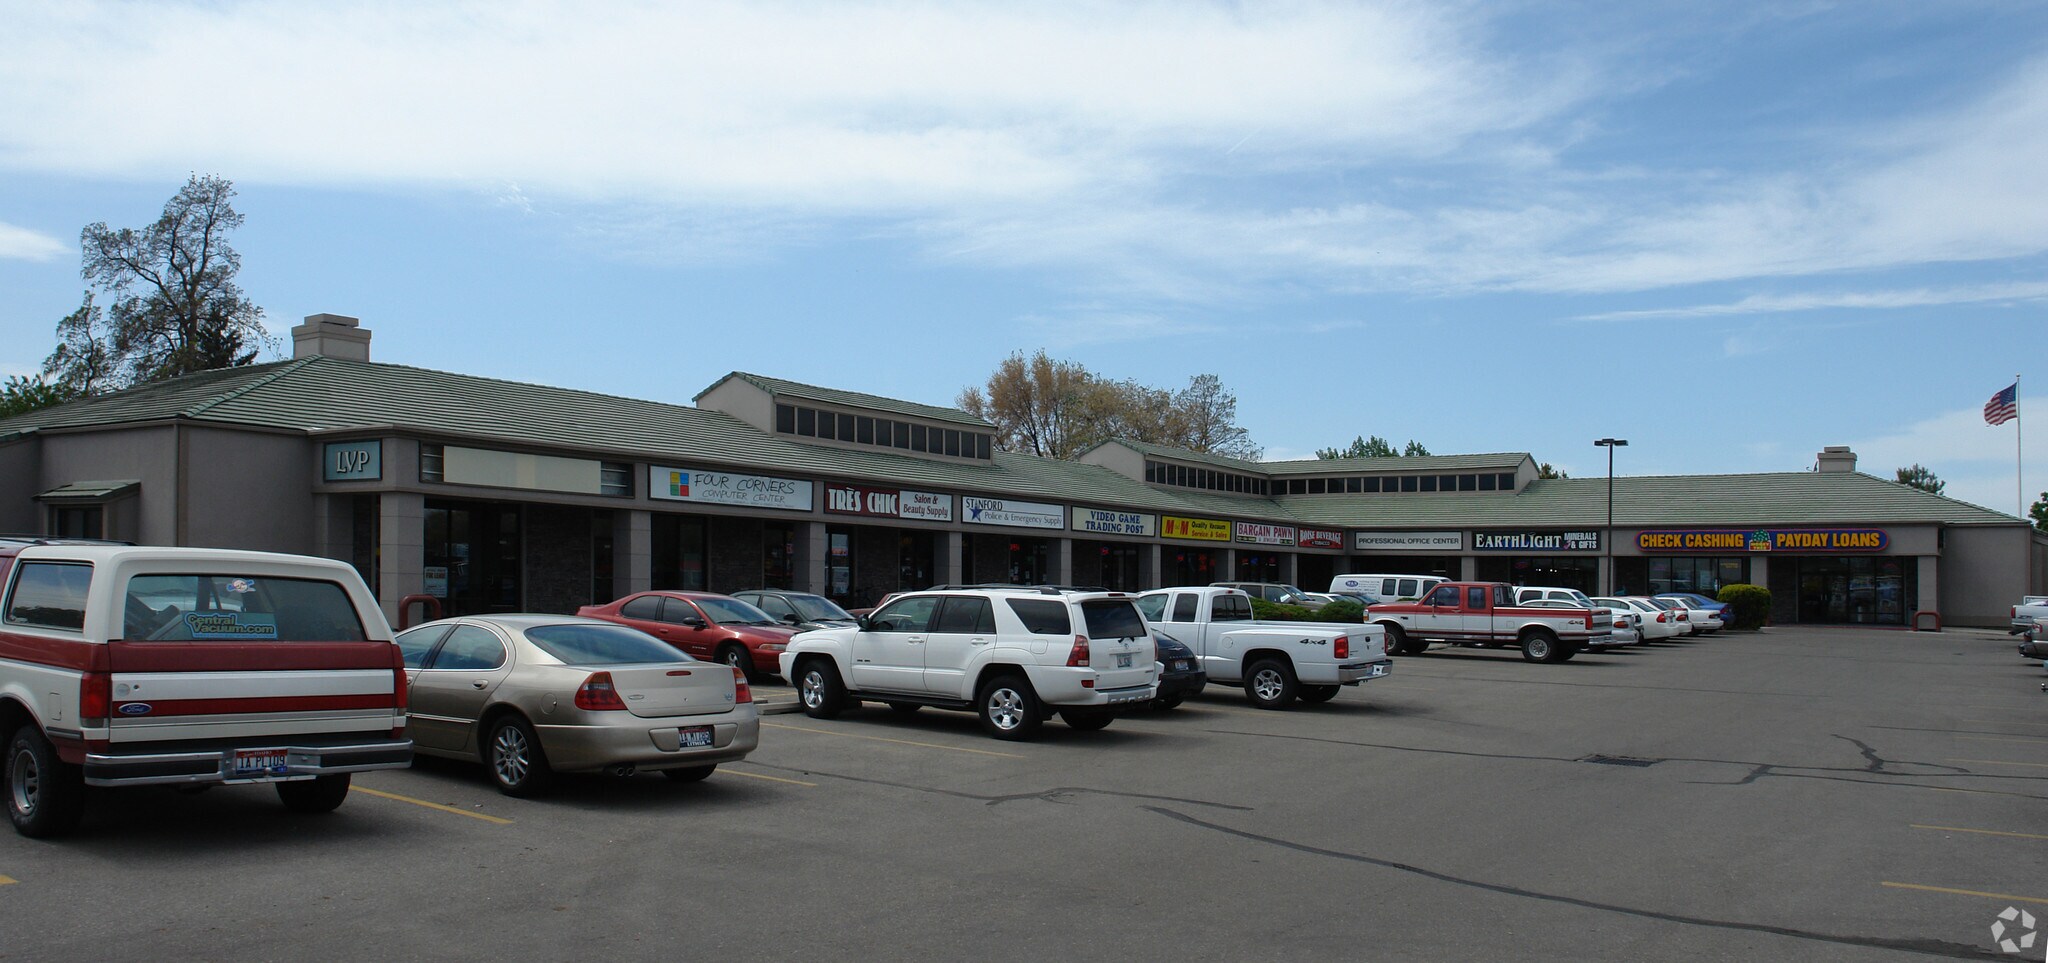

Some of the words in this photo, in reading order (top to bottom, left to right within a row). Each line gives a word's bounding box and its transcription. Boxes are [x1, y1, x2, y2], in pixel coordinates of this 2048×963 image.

[337, 450, 370, 473] LVP
[694, 473, 730, 490] FOUR
[737, 478, 795, 494] CORNERS
[702, 489, 748, 500] COMPUTER
[753, 494, 786, 503] CENTER
[828, 487, 862, 512] TRÈS
[867, 492, 898, 515] CHIC
[914, 493, 931, 504] Salon
[932, 495, 938, 505] &
[903, 503, 926, 517] Beauty
[927, 506, 949, 518] Supply
[966, 498, 1003, 512] STANFORD
[984, 511, 1002, 521] Police
[1003, 513, 1009, 521] &
[1010, 514, 1042, 524] Emergency
[1043, 516, 1062, 526] Supply
[1091, 511, 1116, 522] VIDEO
[1118, 513, 1141, 524] GAME
[1085, 521, 1122, 532] TRADING
[1125, 524, 1144, 534] POST
[1191, 521, 1207, 529] Quality
[1210, 522, 1226, 530] Vacuum
[1238, 523, 1271, 537] BARGAIN
[1273, 526, 1293, 539] PAWN
[1316, 531, 1341, 545] BEVERAGE
[1564, 532, 1597, 540] MINERALS
[1639, 533, 1682, 548] CHECK
[1685, 533, 1744, 548] CASHING
[1776, 532, 1829, 547] PAYDAY
[1832, 532, 1880, 547] LOANS
[1571, 541, 1576, 549] &
[1578, 541, 1597, 549] GIFTS
[187, 614, 236, 625] Central
[191, 620, 274, 633] Vacuum.com
[240, 757, 252, 769] 1A
[255, 755, 285, 768] PL109
